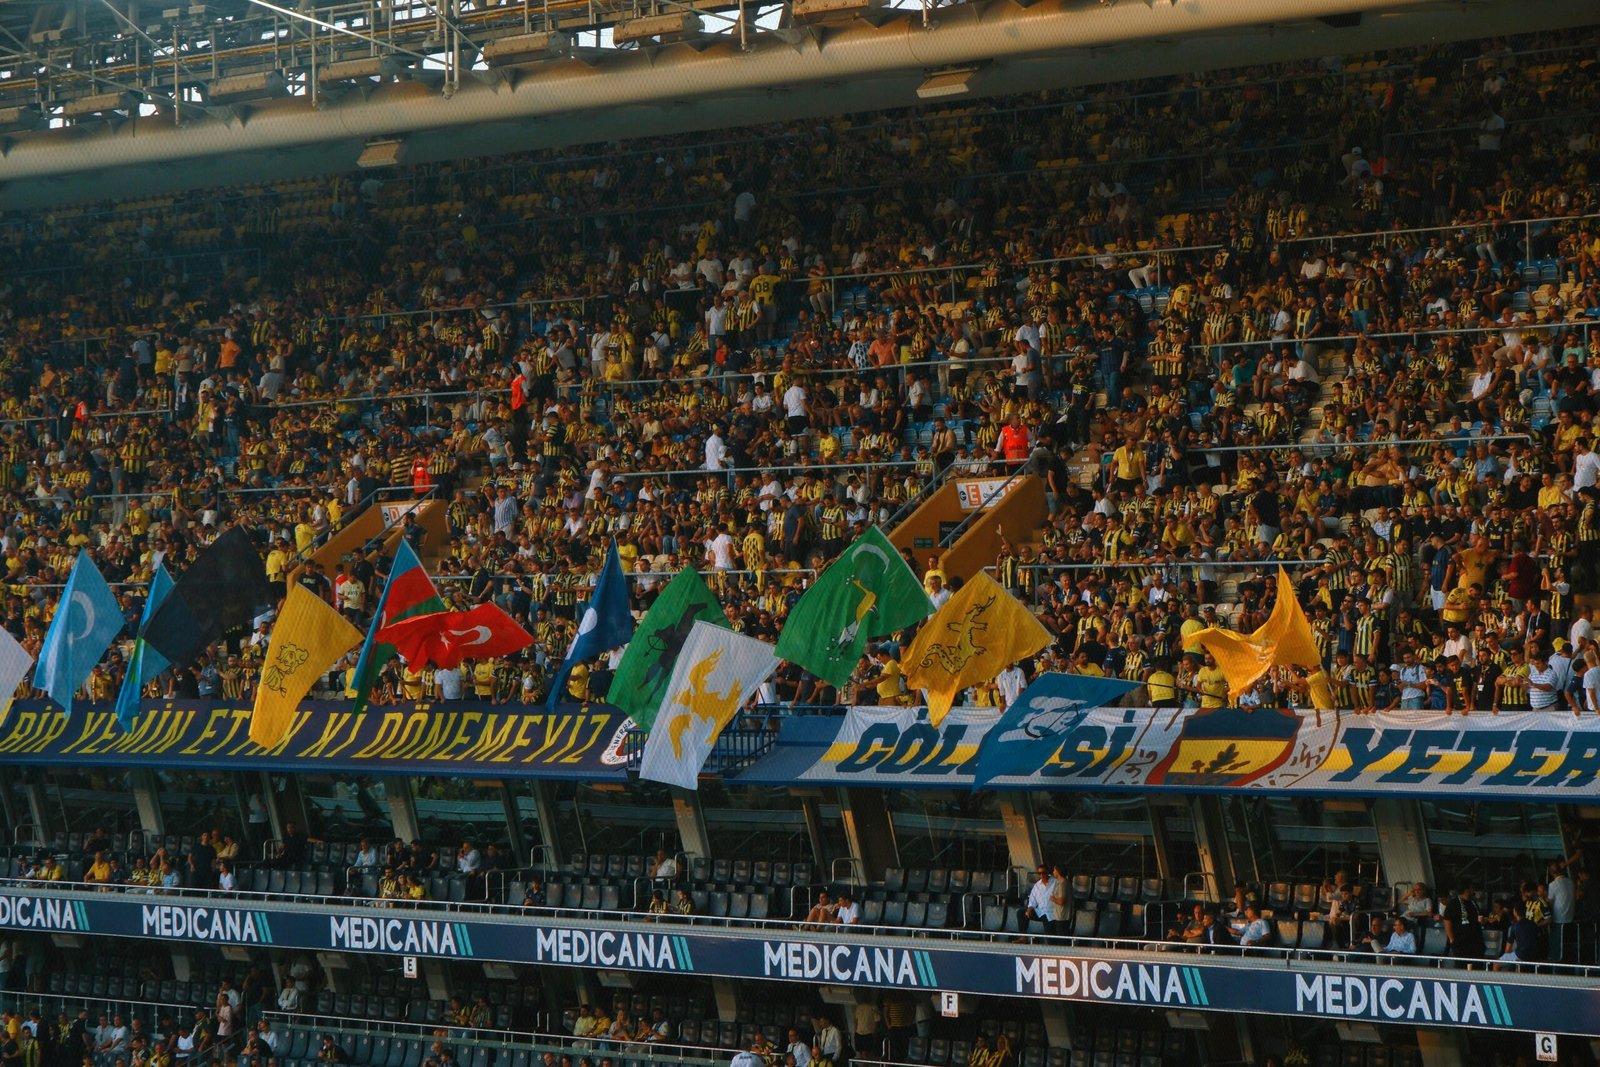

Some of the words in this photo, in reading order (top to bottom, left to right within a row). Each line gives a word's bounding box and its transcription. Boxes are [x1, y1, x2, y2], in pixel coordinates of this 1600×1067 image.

[1215, 252, 1230, 267] 67
[754, 280, 770, 294] 08
[968, 486, 979, 505] E
[0, 705, 71, 753] BİR
[59, 703, 196, 755] YEMİN
[178, 708, 313, 758] ETK
[296, 704, 368, 759] Kİ
[350, 704, 611, 764] DÖNEMEYİZ
[835, 708, 1137, 778] GÖLSİ
[1329, 729, 1600, 788] YETER
[142, 904, 258, 942] MEDICANA
[330, 916, 458, 955] MEDICANA
[407, 958, 413, 972] E
[536, 927, 677, 971] MEDICANA
[763, 940, 918, 987] MEDICANA
[1015, 956, 1187, 1005] MEDICANA
[1295, 973, 1489, 1025] MEDICANA
[946, 994, 953, 1010] F
[1541, 1036, 1552, 1054] G
